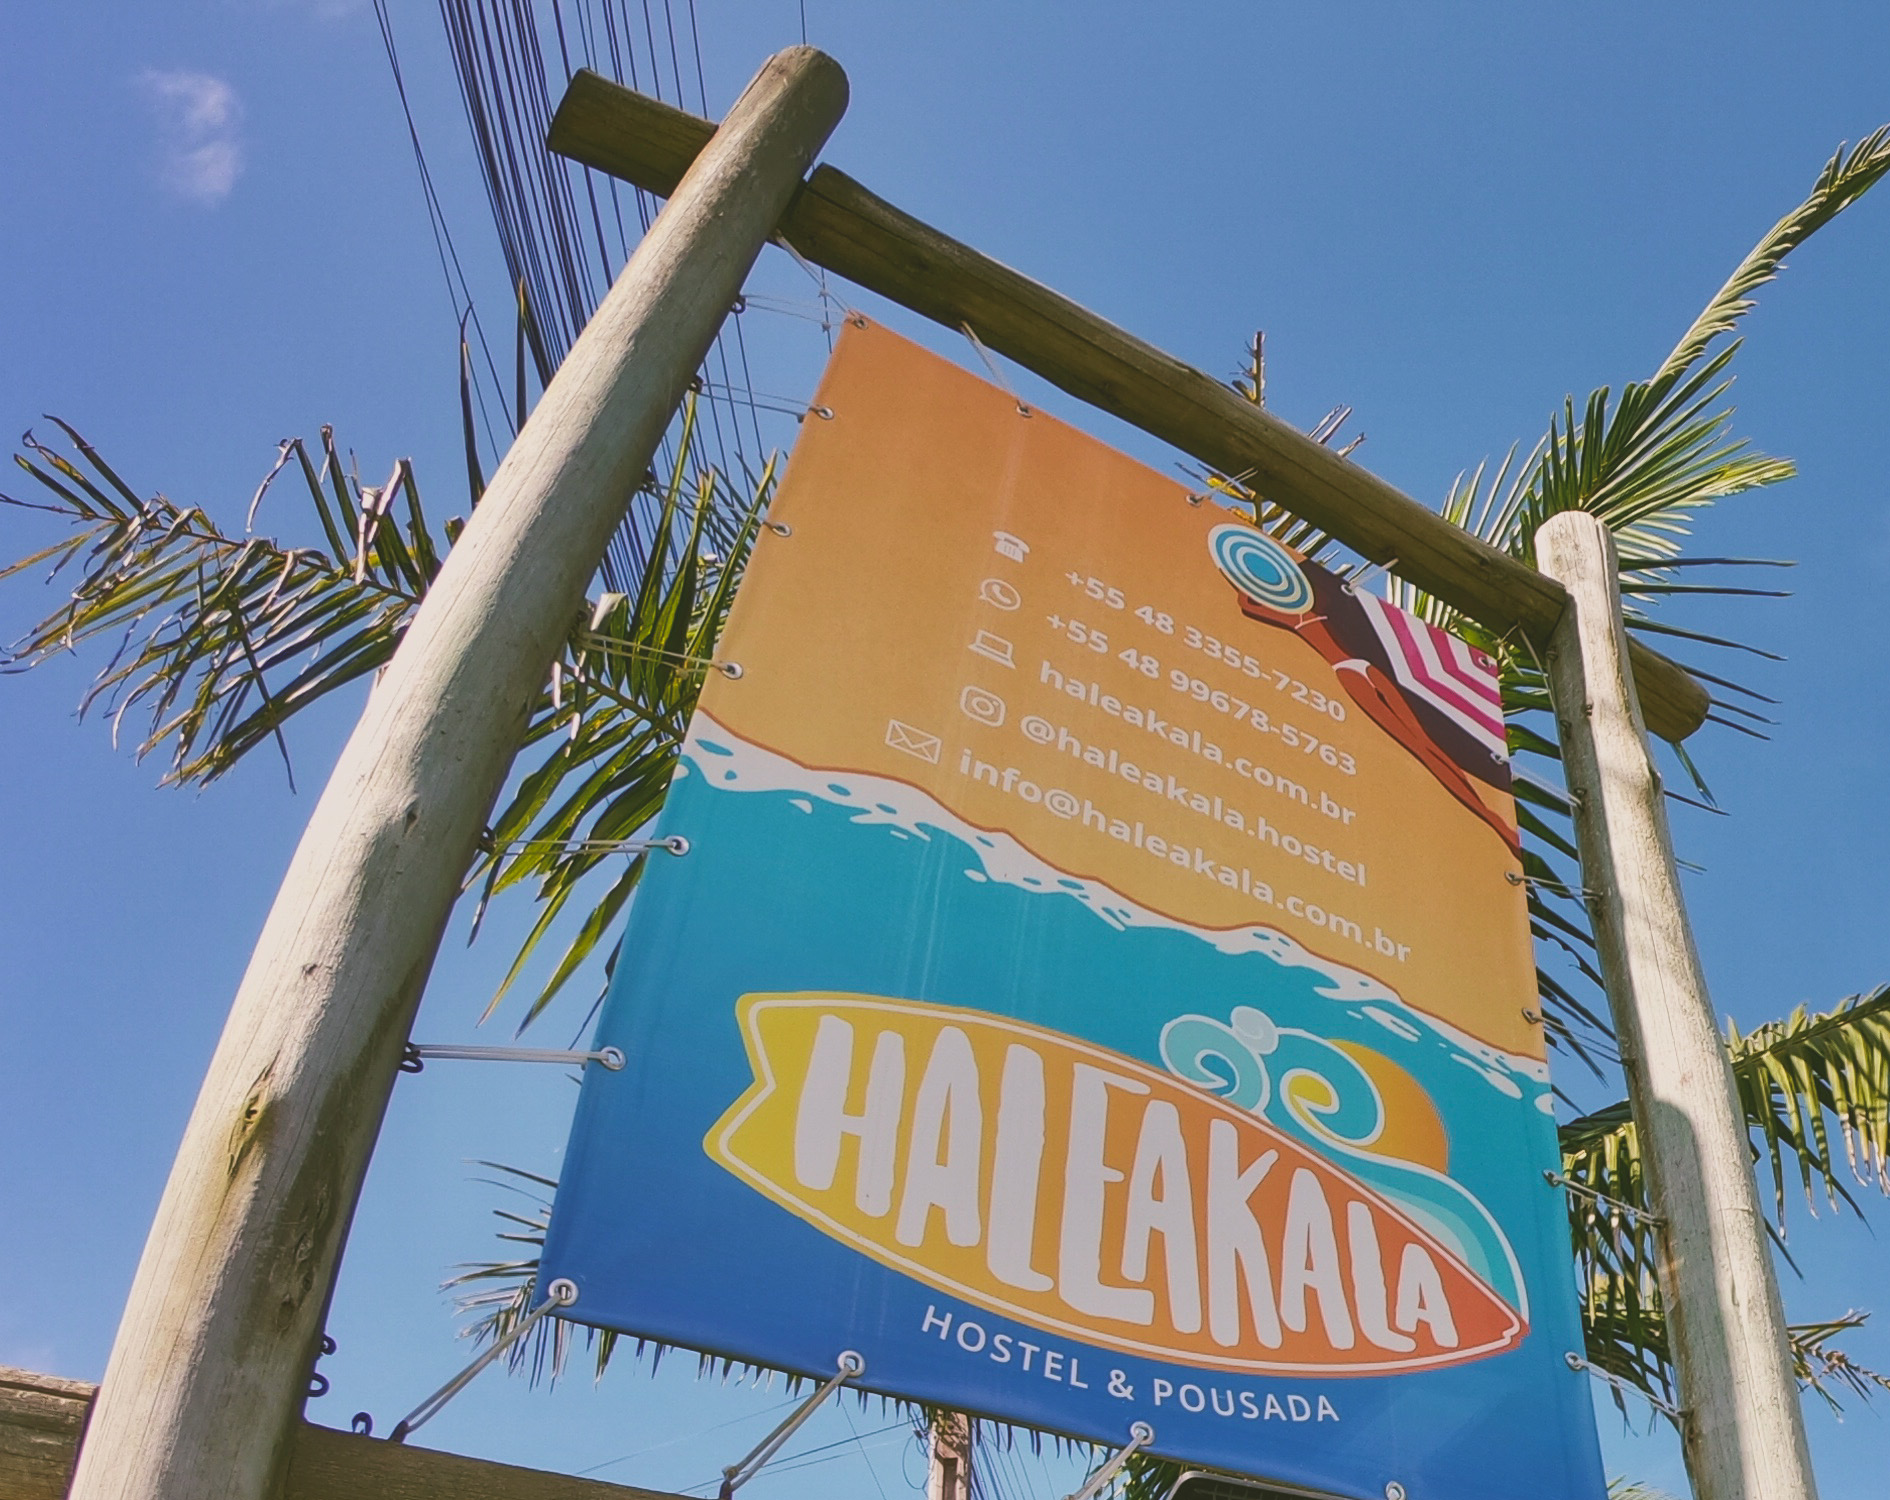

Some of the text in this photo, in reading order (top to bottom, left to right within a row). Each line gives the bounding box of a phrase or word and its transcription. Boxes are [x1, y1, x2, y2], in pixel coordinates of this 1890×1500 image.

[1046, 613, 1357, 776] +55 48 99678-5763
[1065, 569, 1347, 722] +55 48 3355-7230
[1021, 715, 1366, 887] @haleakala.hostel
[1039, 660, 1356, 825] haleakala.com.br
[959, 749, 1411, 963] info@haleakala.com.br
[794, 1013, 1458, 1352] HALEAKALA
[922, 1305, 1340, 1422] HOSTEL & POUSADA
